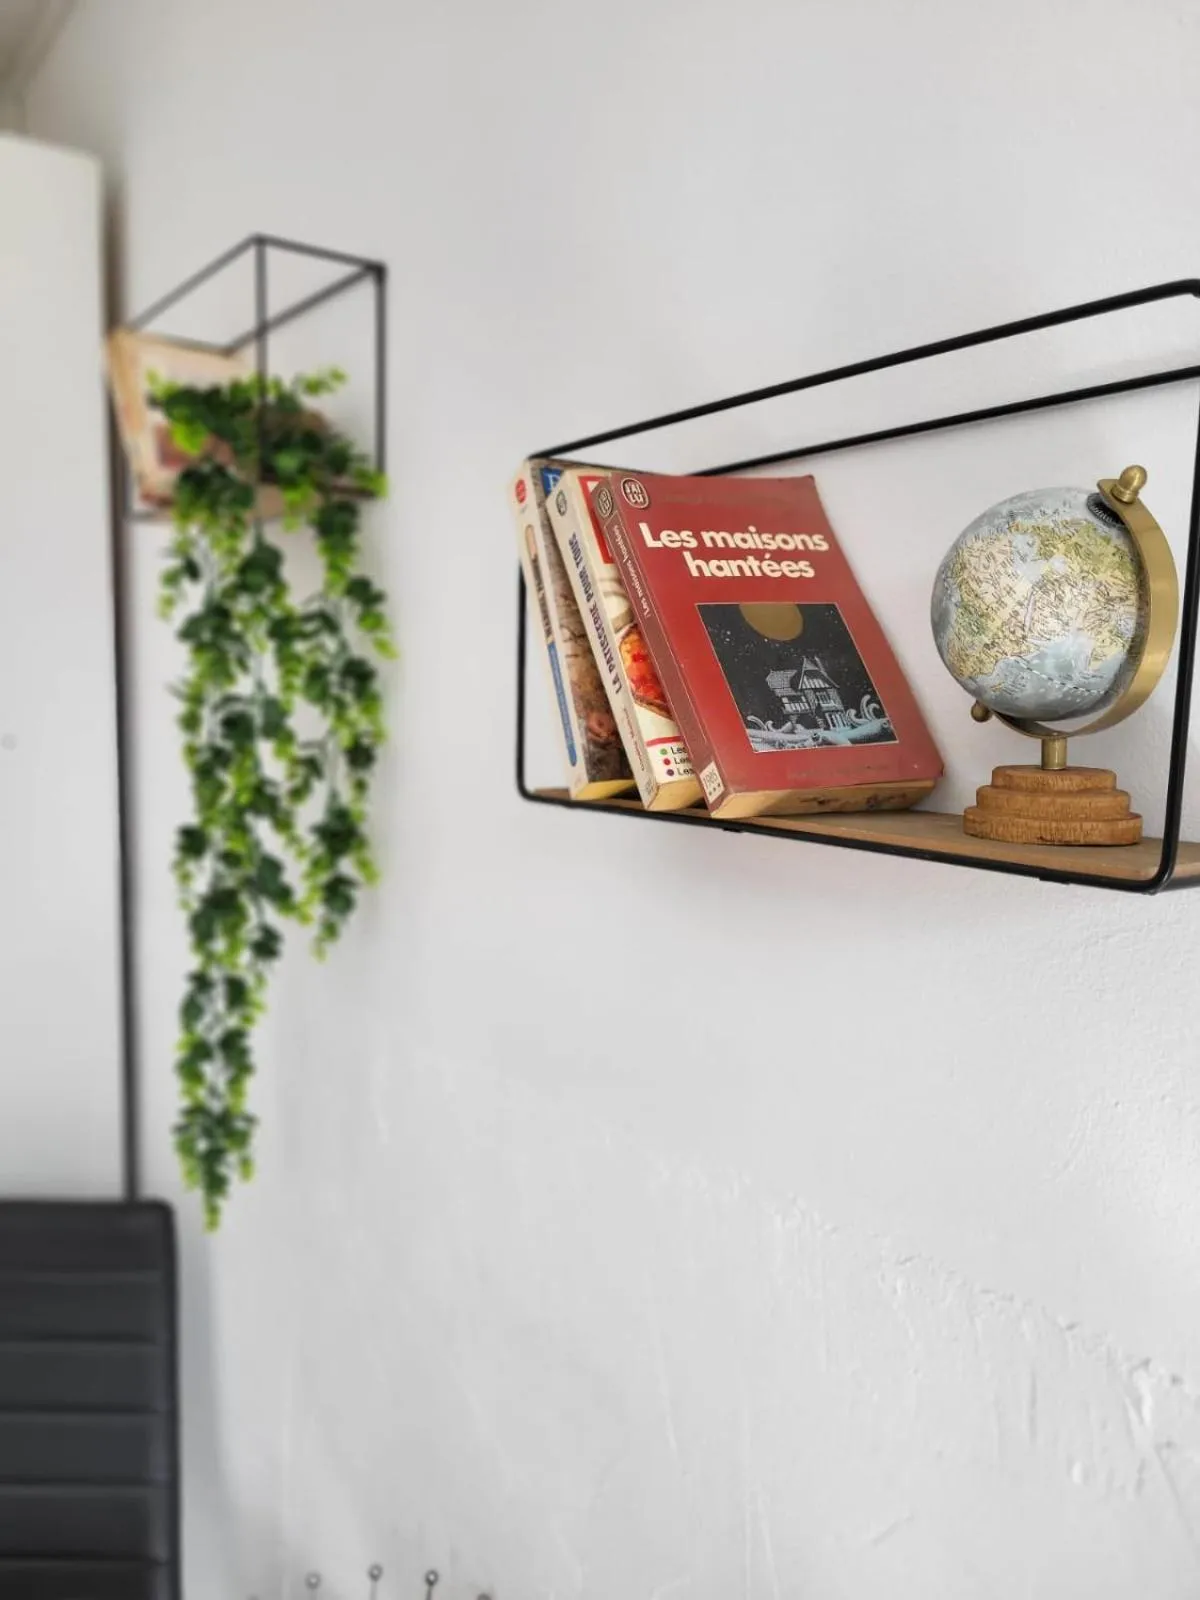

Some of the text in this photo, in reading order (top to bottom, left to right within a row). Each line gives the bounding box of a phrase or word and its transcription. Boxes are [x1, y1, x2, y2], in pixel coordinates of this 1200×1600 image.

[568, 532, 584, 569] TOUS
[639, 522, 829, 551] Les maisons
[683, 551, 815, 578] hantées
[578, 567, 594, 603] POUR
[612, 672, 622, 694] LA
